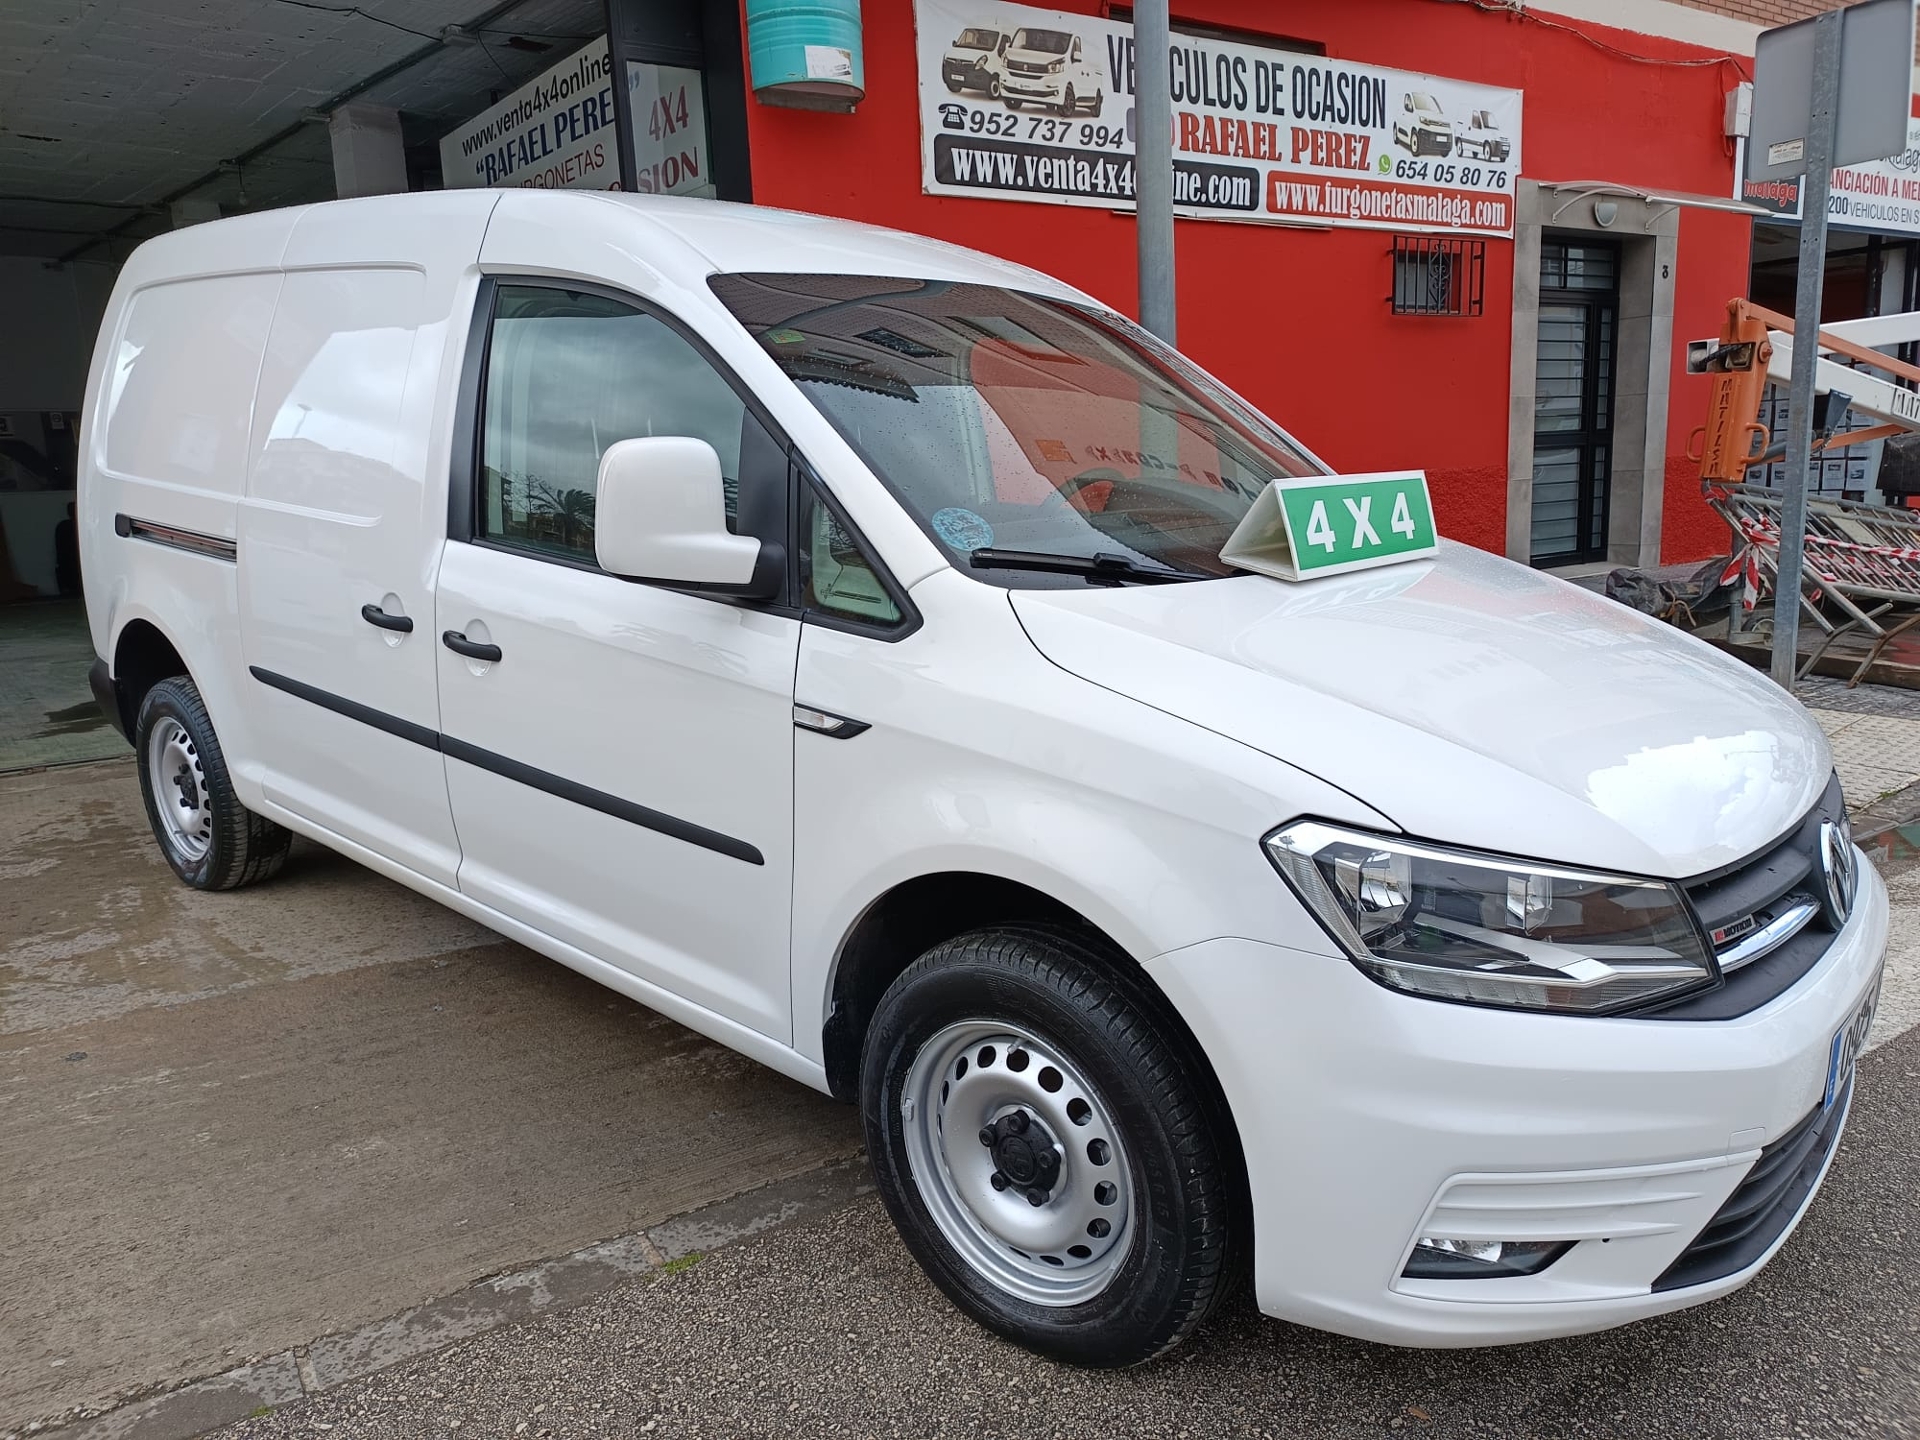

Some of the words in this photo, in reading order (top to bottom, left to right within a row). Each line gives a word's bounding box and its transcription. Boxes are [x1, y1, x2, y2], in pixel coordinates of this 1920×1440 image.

[1106, 34, 1248, 111] VECULOS
[1254, 59, 1286, 117] DE
[1291, 64, 1386, 130] OCASION
[553, 87, 615, 149] PERE
[649, 85, 689, 142] 4X4
[968, 109, 1019, 138] 952
[1027, 116, 1073, 144] 737
[1079, 123, 1124, 149] 994
[1179, 112, 1282, 161] RAFAEL
[1290, 126, 1371, 171] PEREZ
[951, 147, 1250, 206] www.venta4x4ine.com
[1395, 159, 1428, 182] 654
[1433, 164, 1455, 184] 05
[1459, 166, 1481, 187] 80
[1487, 169, 1507, 189] 76
[1890, 178, 1899, 199] A
[1274, 179, 1506, 227] www.furgonetasmalaga.com
[1849, 201, 1899, 222] VEHICULOS
[1901, 206, 1912, 224] EN
[1913, 208, 1920, 225] S
[1306, 499, 1336, 553] 4
[1342, 495, 1382, 549] X
[1390, 491, 1415, 540] 4
[1714, 917, 1753, 943] MOTION
